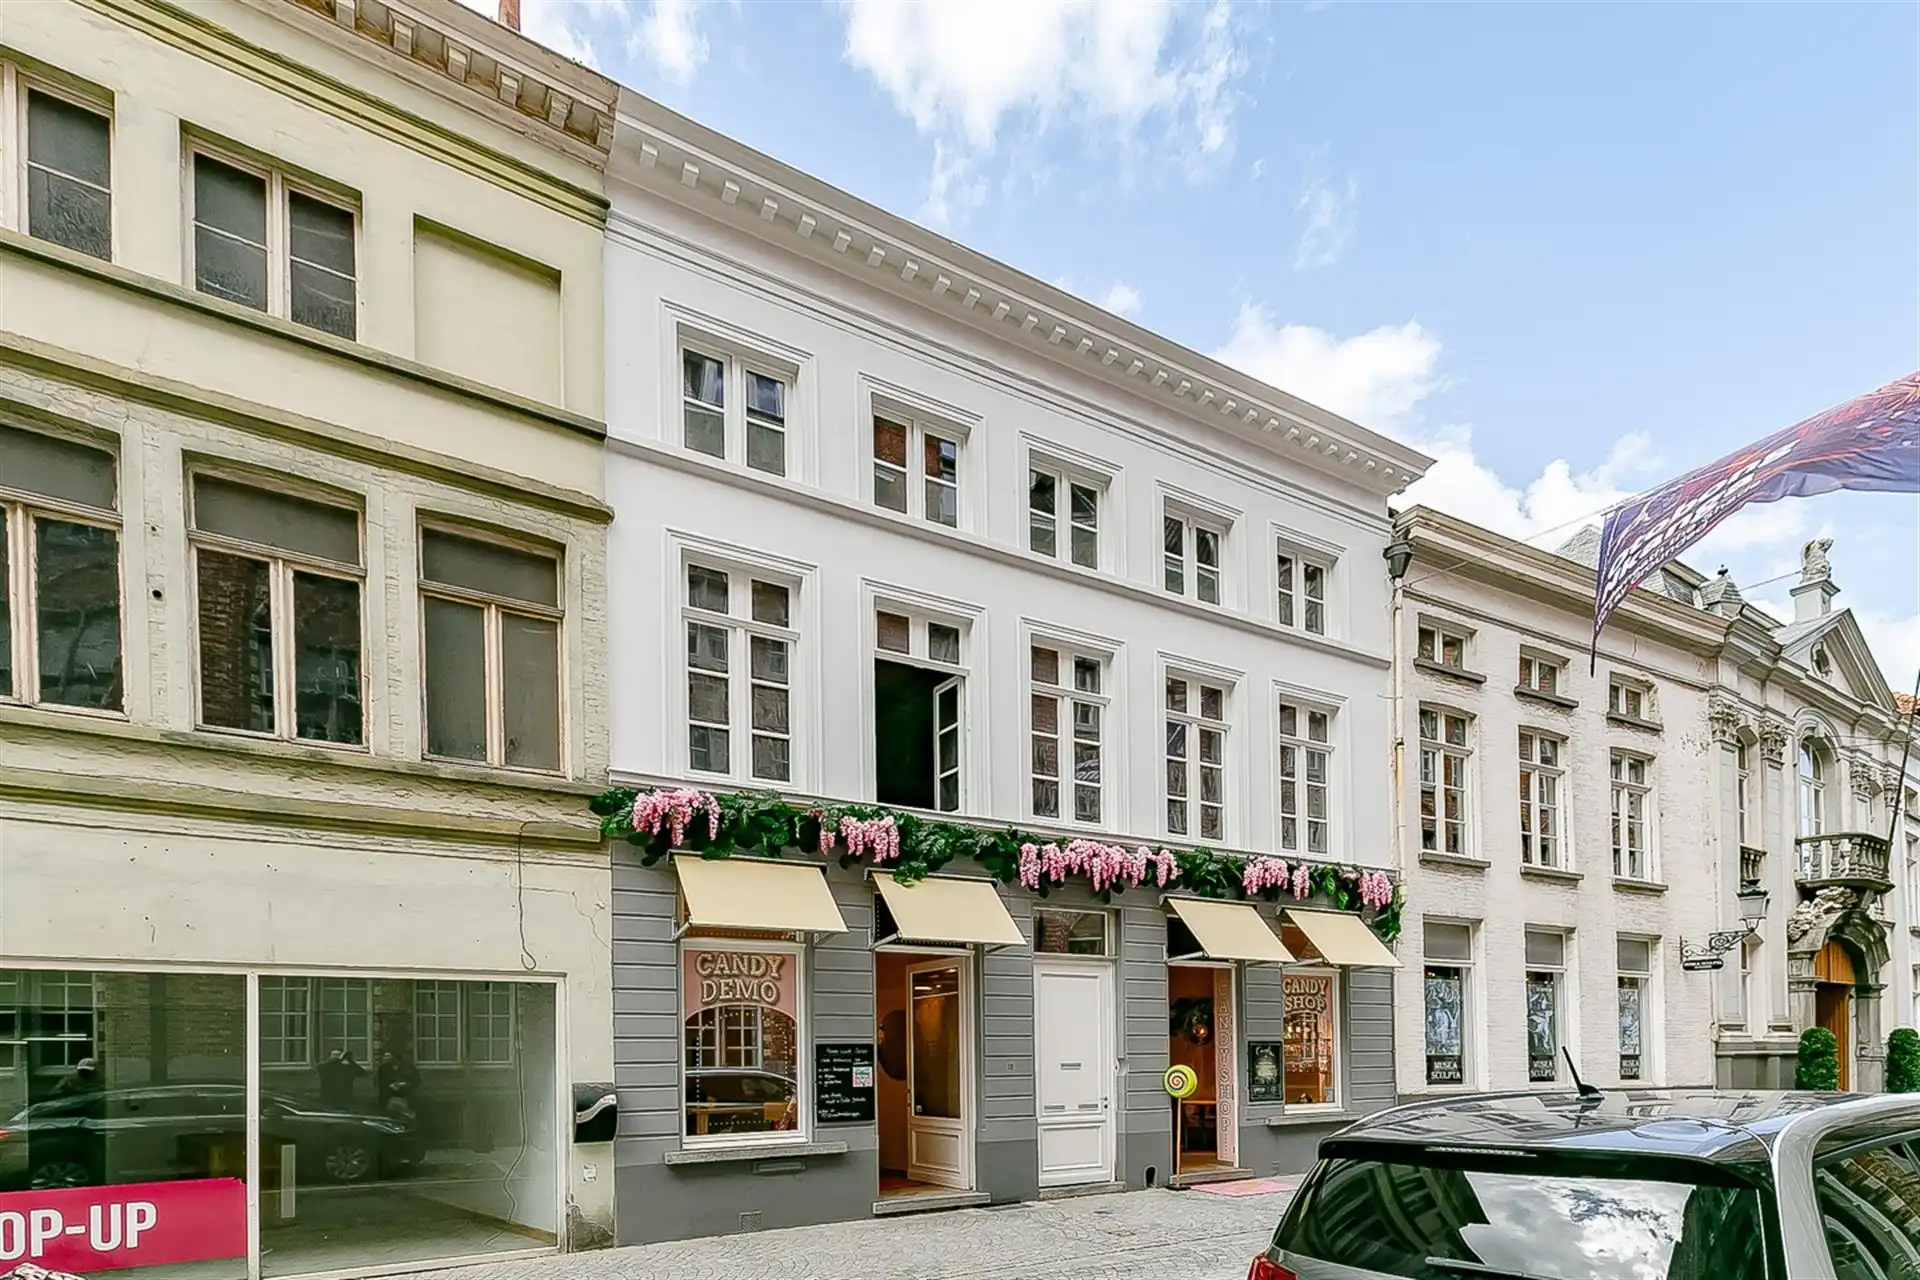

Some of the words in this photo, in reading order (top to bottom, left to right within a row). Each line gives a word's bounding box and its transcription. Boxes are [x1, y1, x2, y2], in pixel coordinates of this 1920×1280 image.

[696, 953, 784, 978] CANDY
[702, 979, 778, 1003] DEMO
[1283, 979, 1327, 995] CANDY
[1284, 996, 1326, 1012] SHOP
[1218, 984, 1231, 1063] CANDY
[1219, 1067, 1232, 1131] SHOP
[0, 1201, 157, 1260] OP-UP
